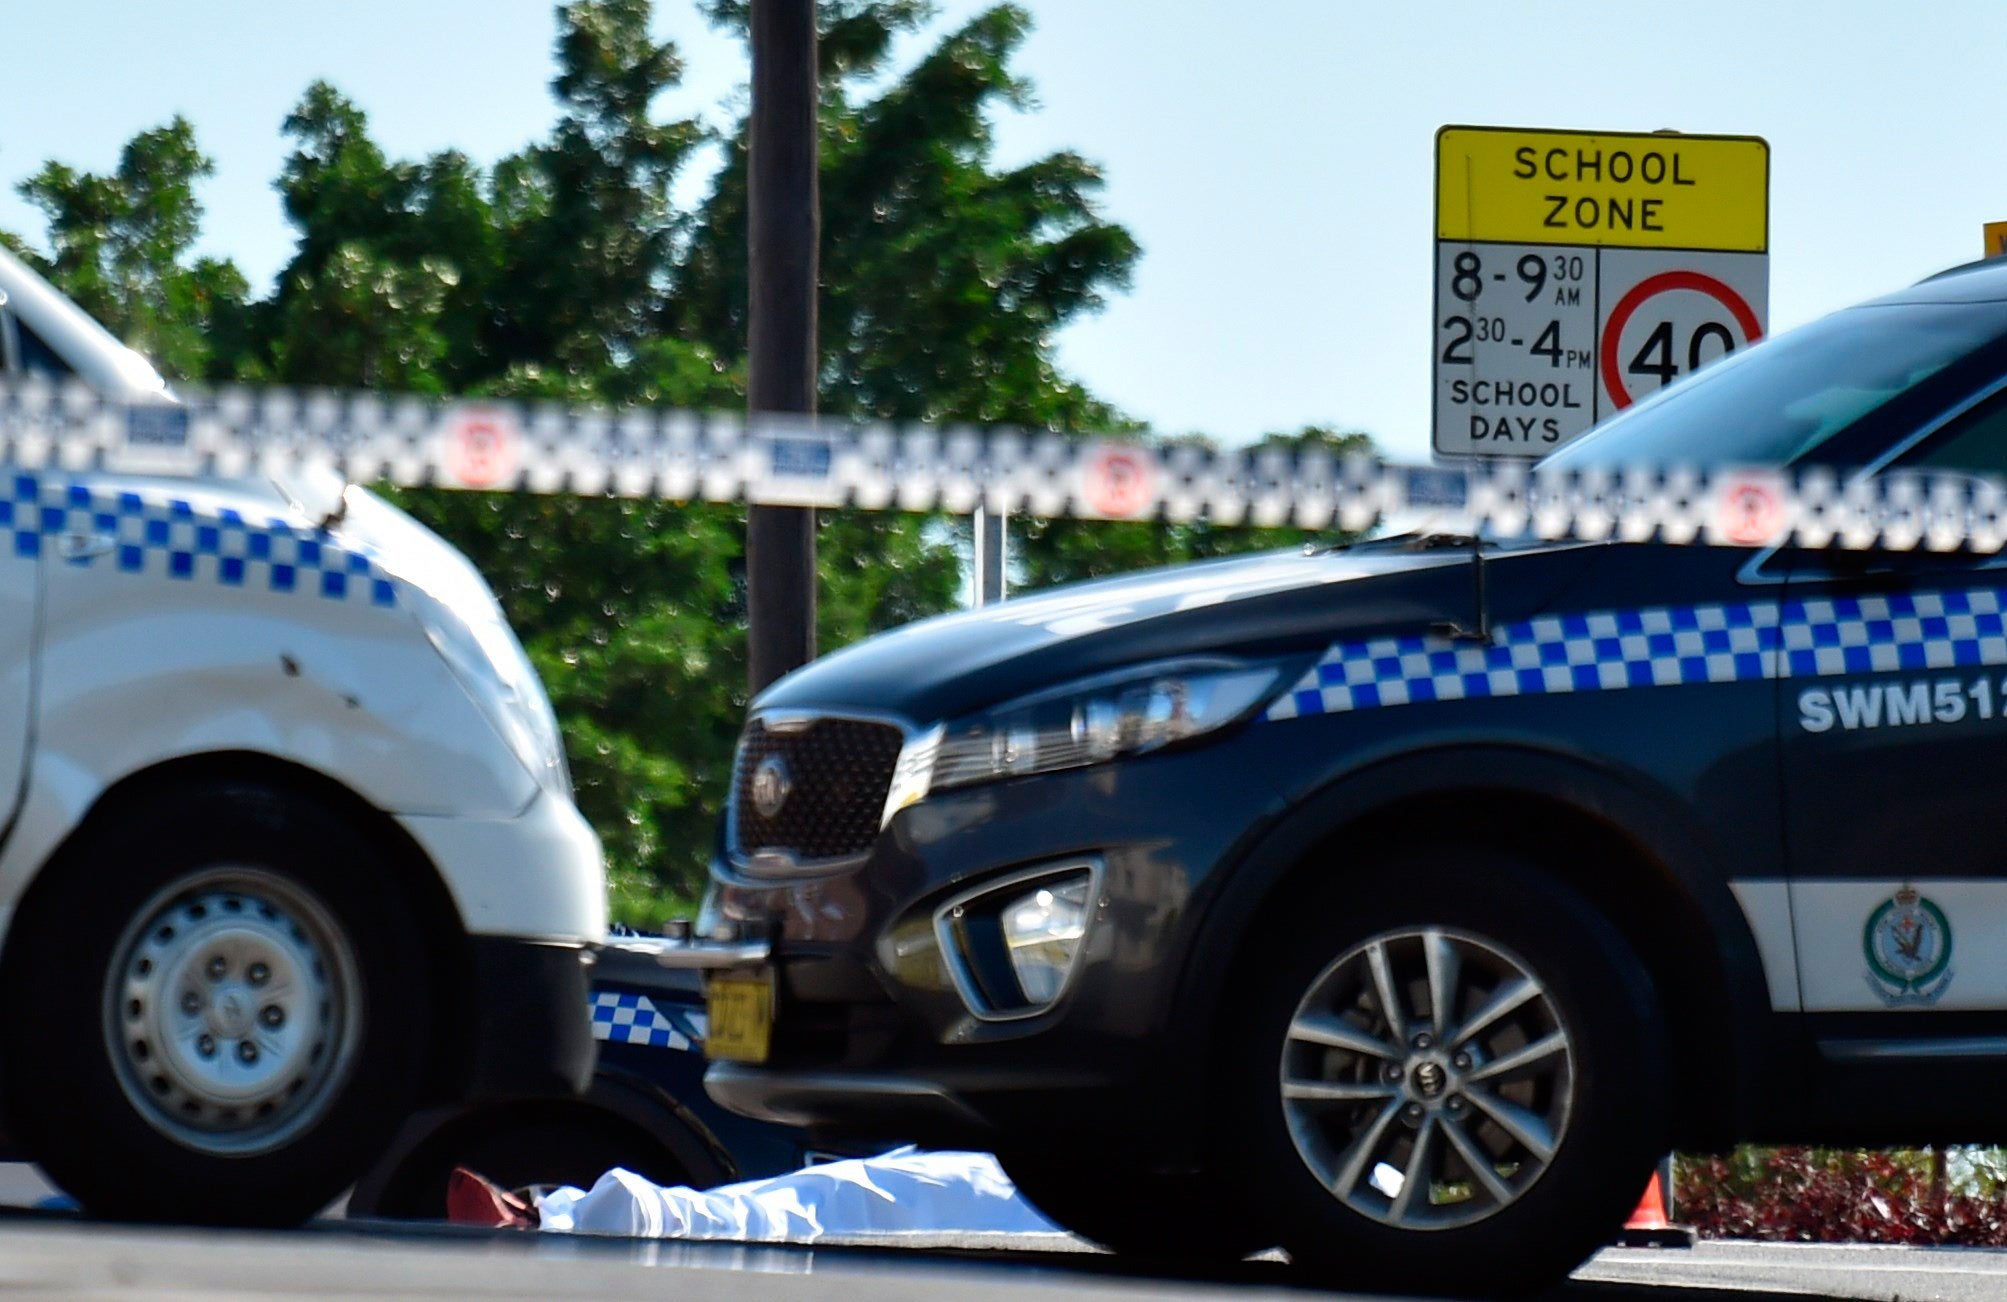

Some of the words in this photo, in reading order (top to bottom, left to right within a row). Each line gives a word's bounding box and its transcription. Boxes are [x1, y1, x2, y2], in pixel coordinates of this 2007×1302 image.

[1513, 147, 1696, 186] SCHOOL
[1543, 196, 1664, 232] ZONE
[1555, 288, 1580, 307] AM
[1628, 321, 1735, 388] 40
[1450, 380, 1581, 409] SCHOOL
[1470, 415, 1560, 443] DAYS
[1799, 677, 2007, 732] SWM51
